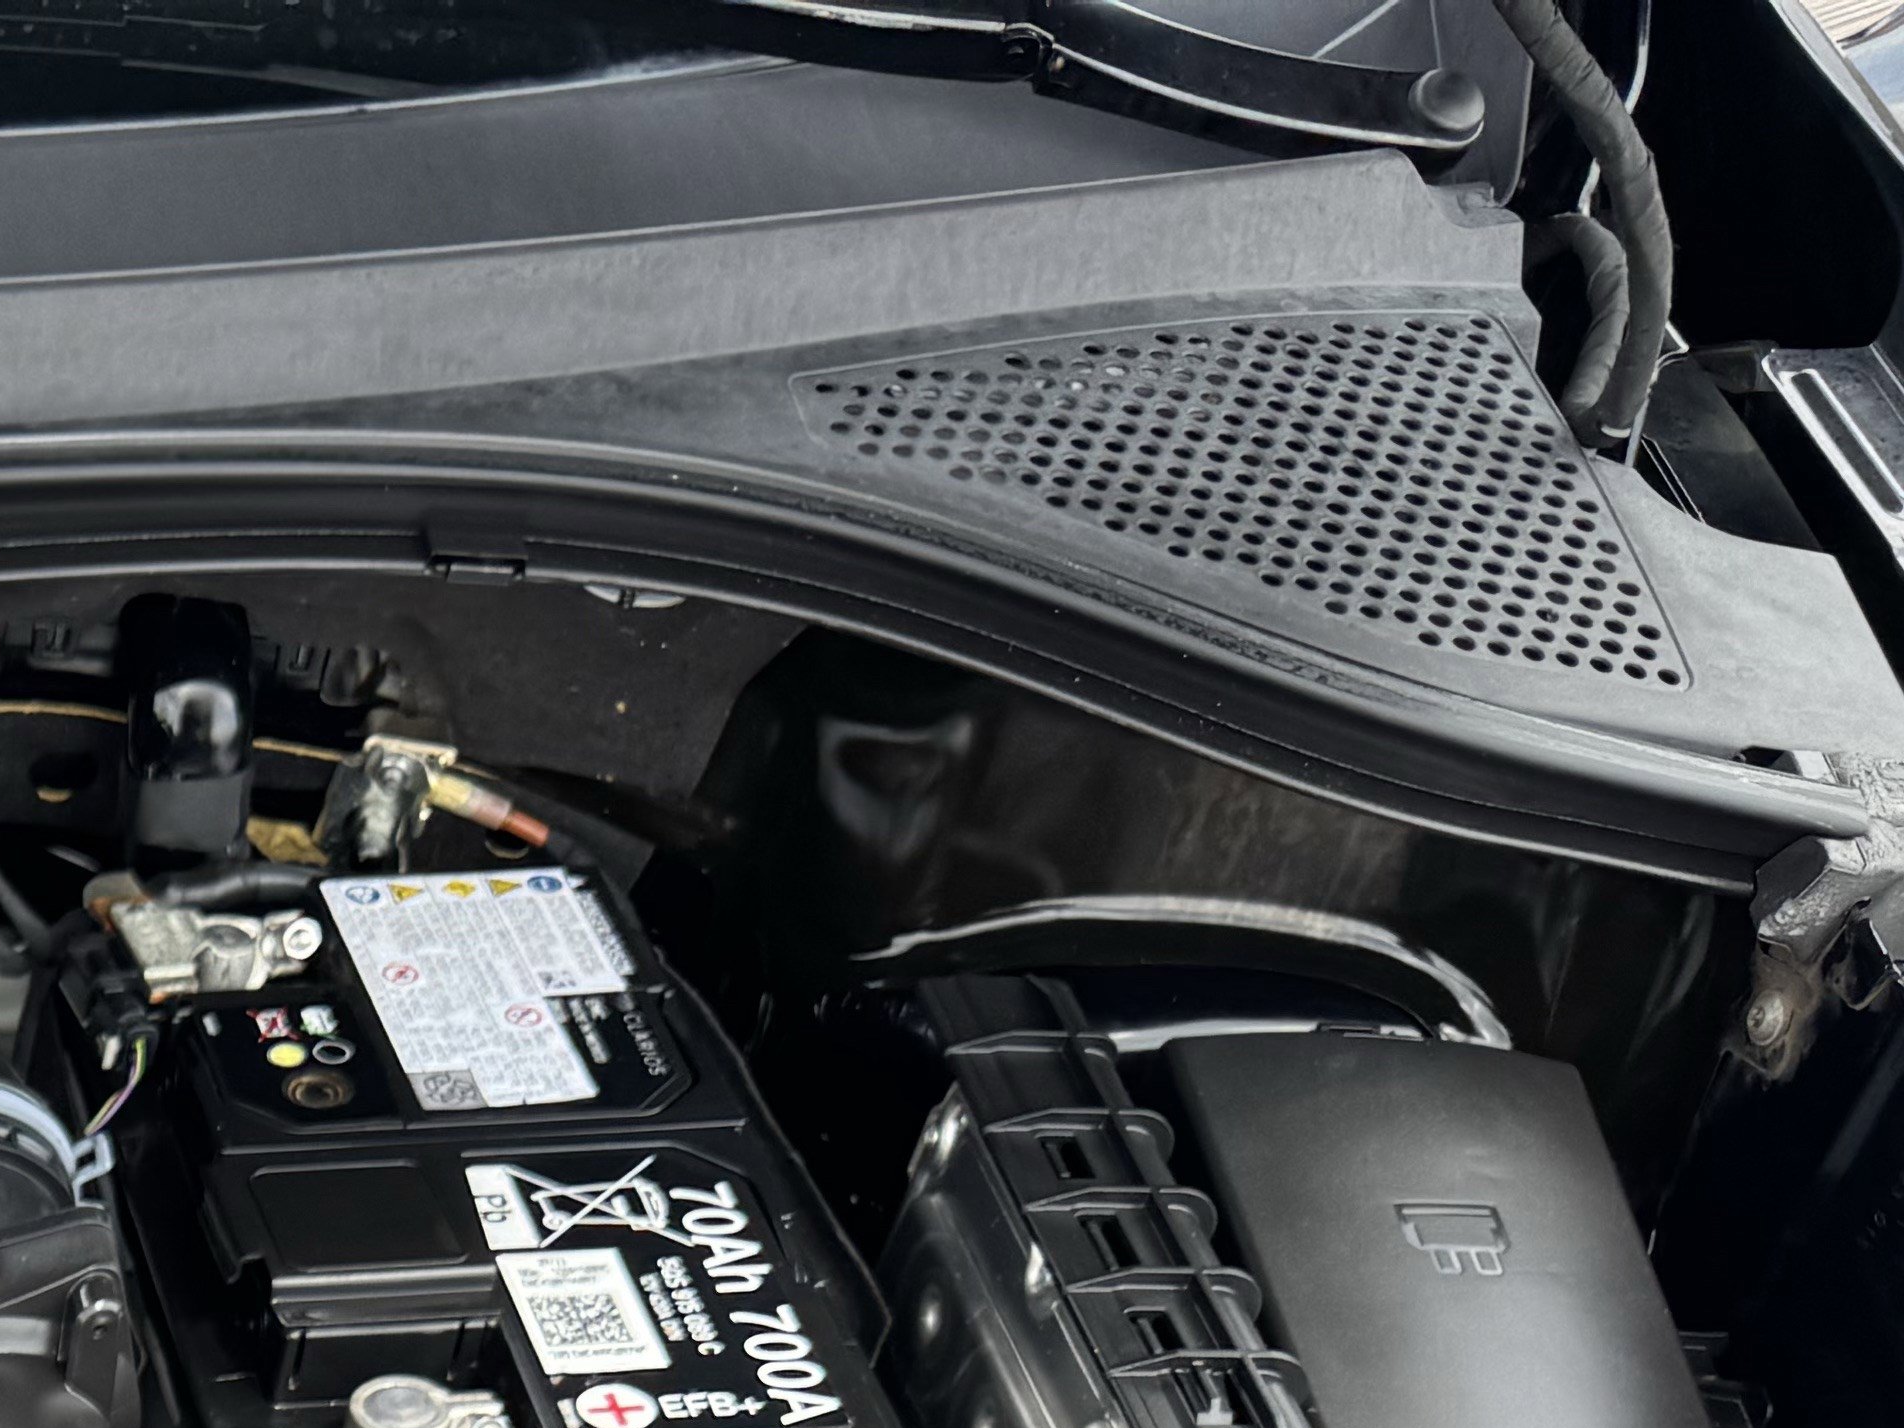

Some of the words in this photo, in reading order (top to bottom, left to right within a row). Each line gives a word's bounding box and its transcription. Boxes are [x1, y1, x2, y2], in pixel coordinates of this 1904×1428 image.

[478, 1193, 510, 1224] Pb
[669, 1181, 774, 1293] 70Ah
[729, 1304, 844, 1426] 700A
[658, 1391, 768, 1419] EFB+
